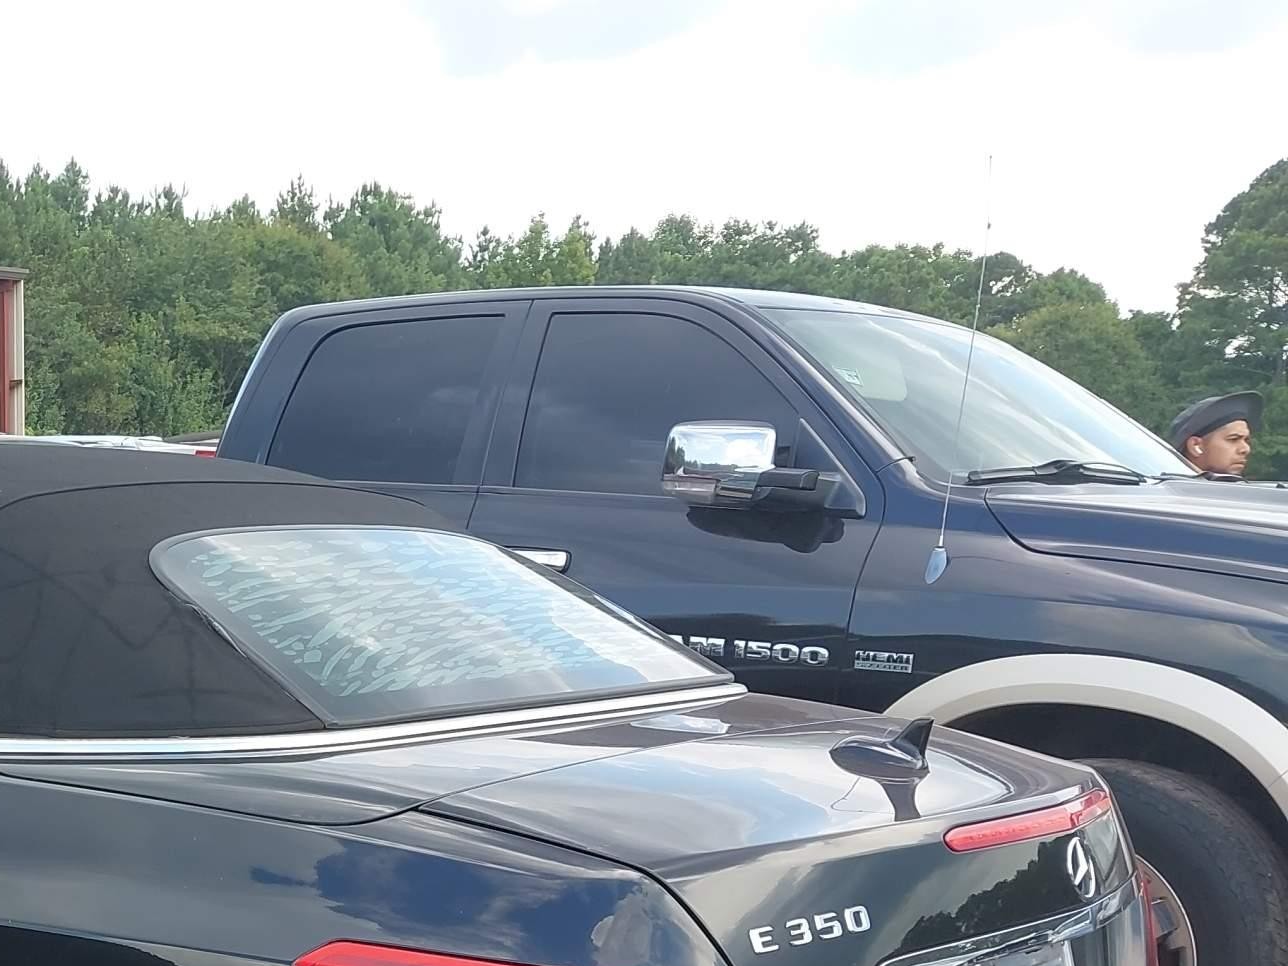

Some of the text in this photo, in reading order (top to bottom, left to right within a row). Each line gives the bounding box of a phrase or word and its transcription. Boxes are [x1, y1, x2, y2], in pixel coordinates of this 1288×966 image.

[733, 640, 830, 666] 1500
[855, 650, 914, 665] HEMI
[749, 905, 871, 954] E 350
